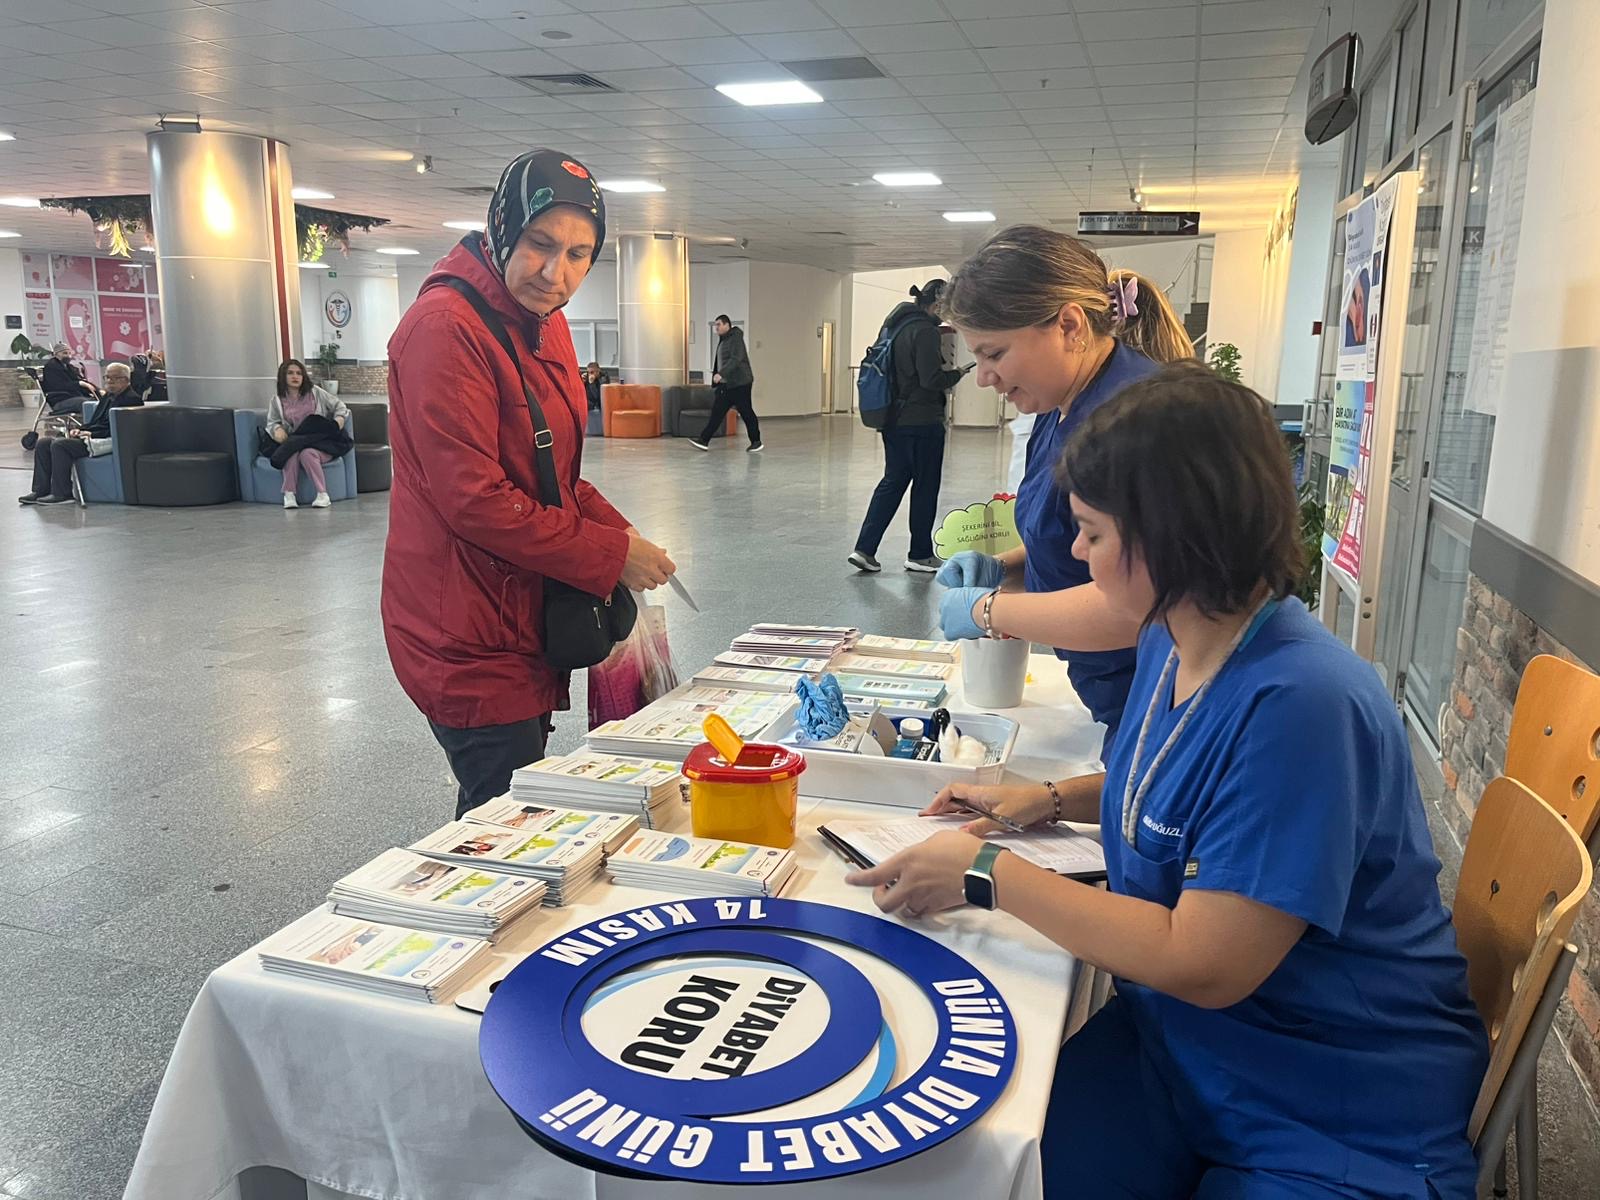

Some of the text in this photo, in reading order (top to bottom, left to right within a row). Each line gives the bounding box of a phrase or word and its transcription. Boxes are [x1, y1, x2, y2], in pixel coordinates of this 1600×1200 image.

[962, 521, 989, 532] ŞEKERİNİ
[540, 897, 767, 967] 14 KASIM
[620, 974, 740, 1073] KORU
[691, 976, 807, 1081] DİYABET
[538, 978, 1005, 1172] DÜNYA DİYABET GÜNÜ
